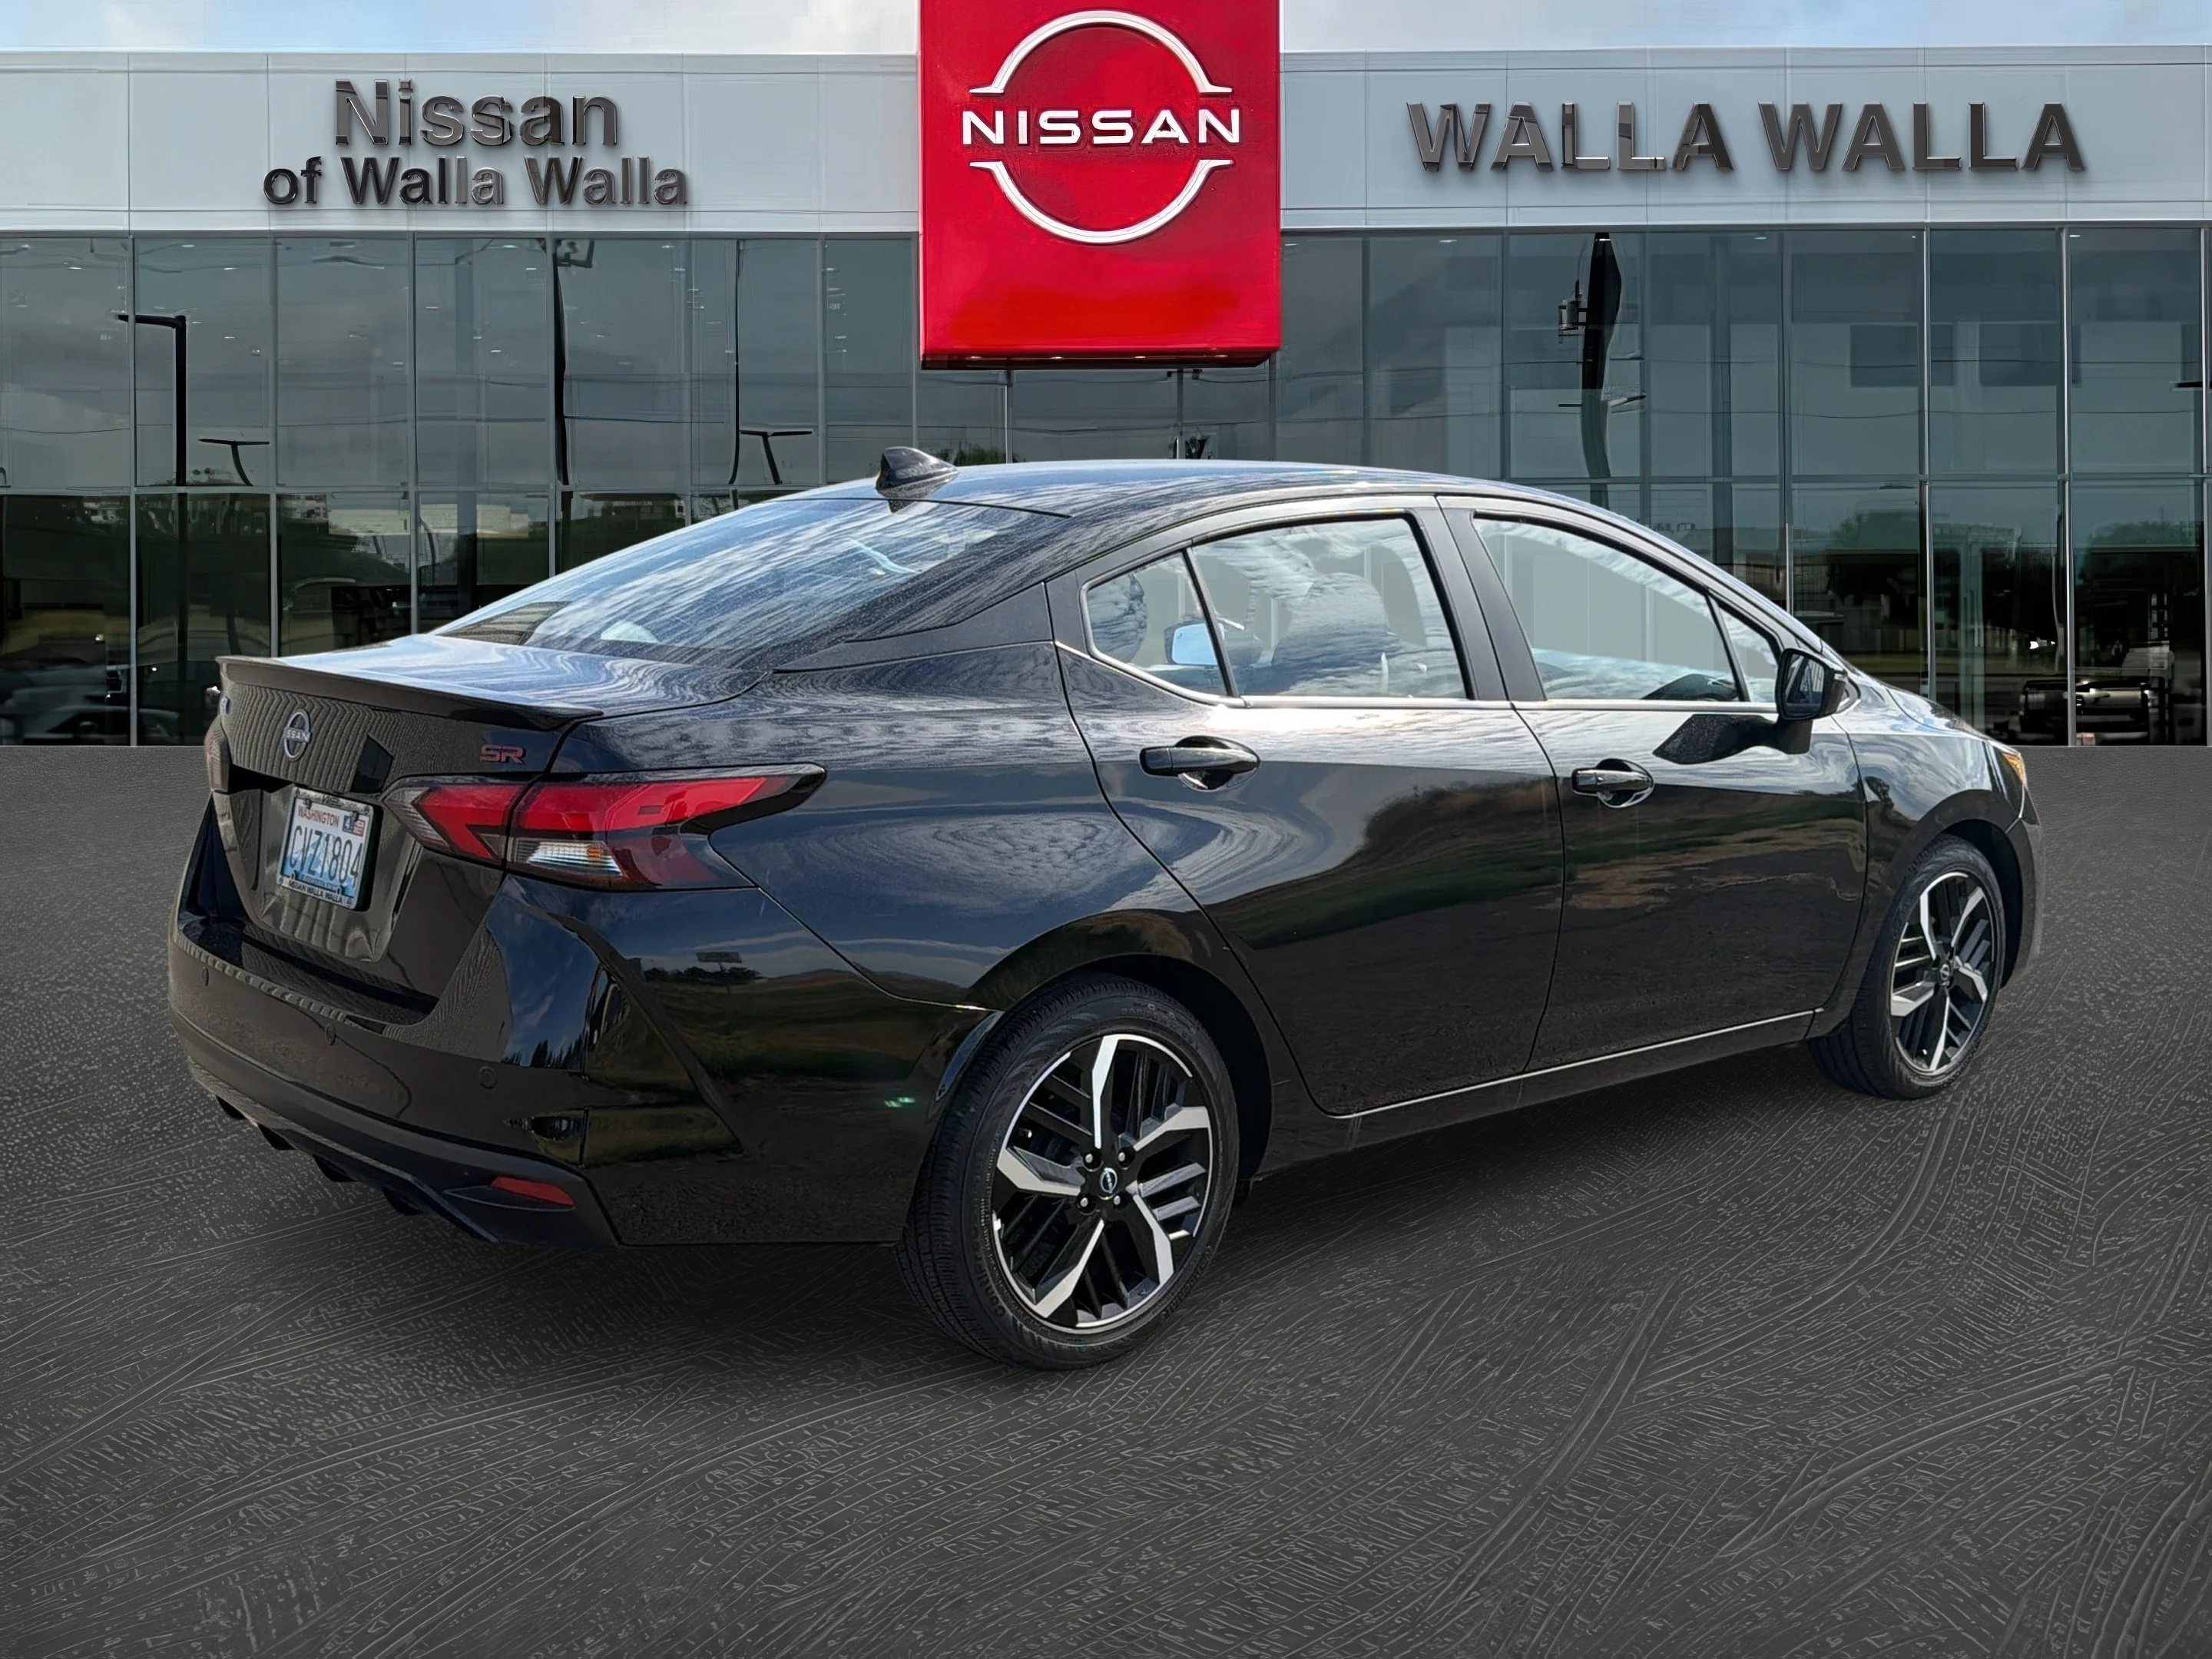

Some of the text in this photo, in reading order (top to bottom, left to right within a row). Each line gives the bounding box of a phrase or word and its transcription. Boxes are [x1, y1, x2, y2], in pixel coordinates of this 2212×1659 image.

[334, 78, 619, 146] Nissan
[962, 108, 1242, 146] NISSAN
[1406, 101, 2086, 172] WALLA WALLA
[263, 154, 687, 206] of Walla Walla
[481, 743, 524, 764] SR
[297, 805, 339, 828] WASHINGTON
[290, 825, 363, 889] CVZ1804
